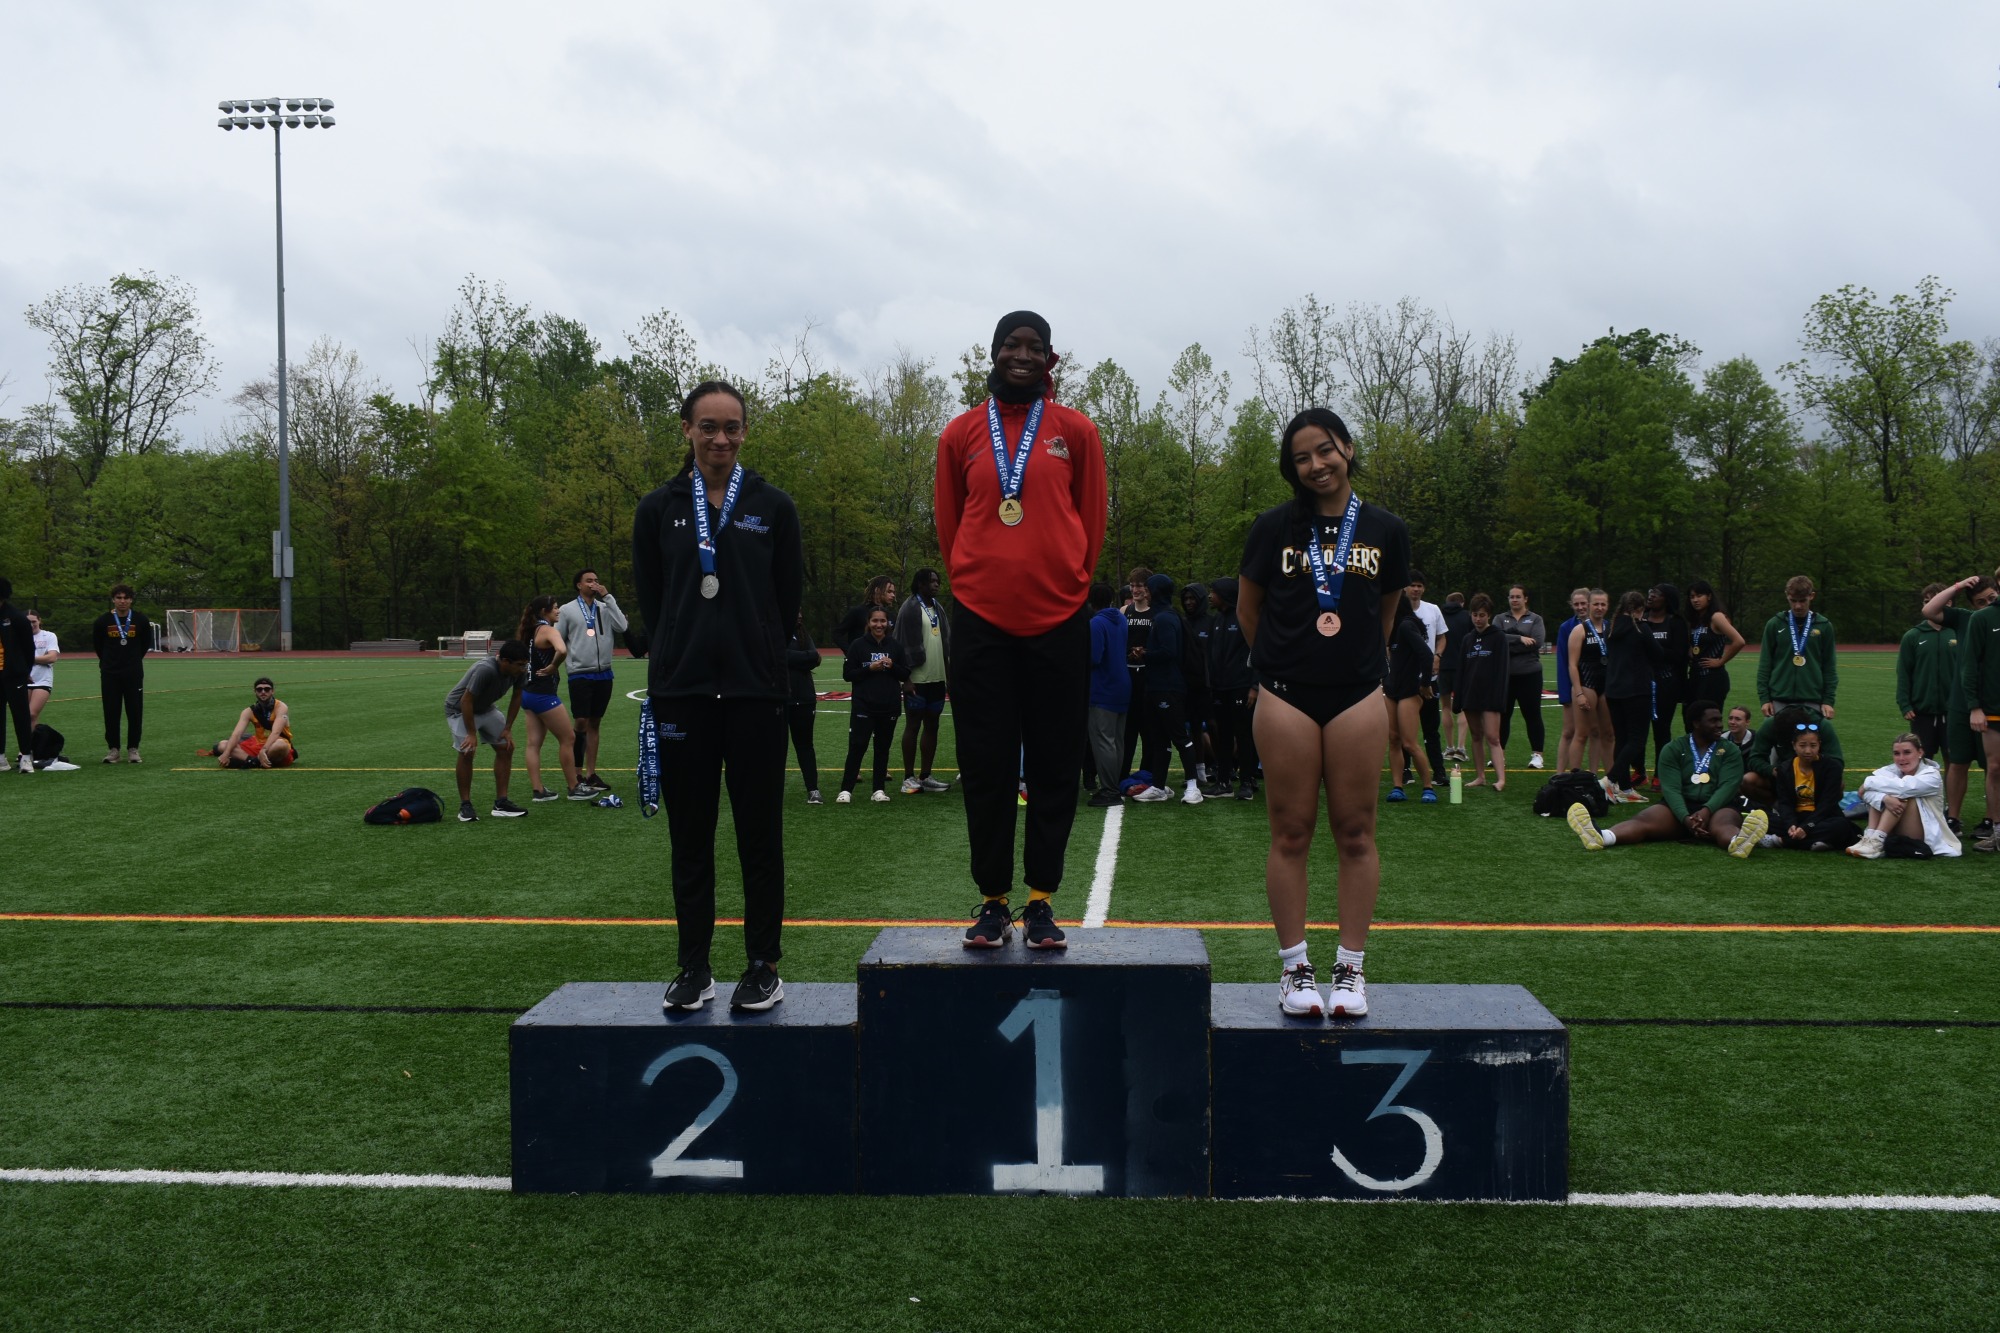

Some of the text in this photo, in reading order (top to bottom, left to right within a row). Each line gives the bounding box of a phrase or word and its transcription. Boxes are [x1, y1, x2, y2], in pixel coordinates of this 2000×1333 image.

[993, 431, 1003, 450] EAST
[1010, 451, 1027, 490] ATLANTIC
[1021, 431, 1033, 450] EAST
[695, 477, 704, 496] EAST
[727, 482, 738, 502] EAST
[696, 498, 708, 537] ATLANTIC
[1346, 500, 1358, 521] EAST
[1336, 522, 1353, 562] CONFERENCE
[1310, 544, 1326, 581] ATLANTIC
[646, 731, 656, 753] EAST
[649, 755, 657, 801] CONFERENCE
[993, 989, 1103, 1190] 1
[642, 1044, 743, 1178] 2
[1330, 1050, 1443, 1190] 3
